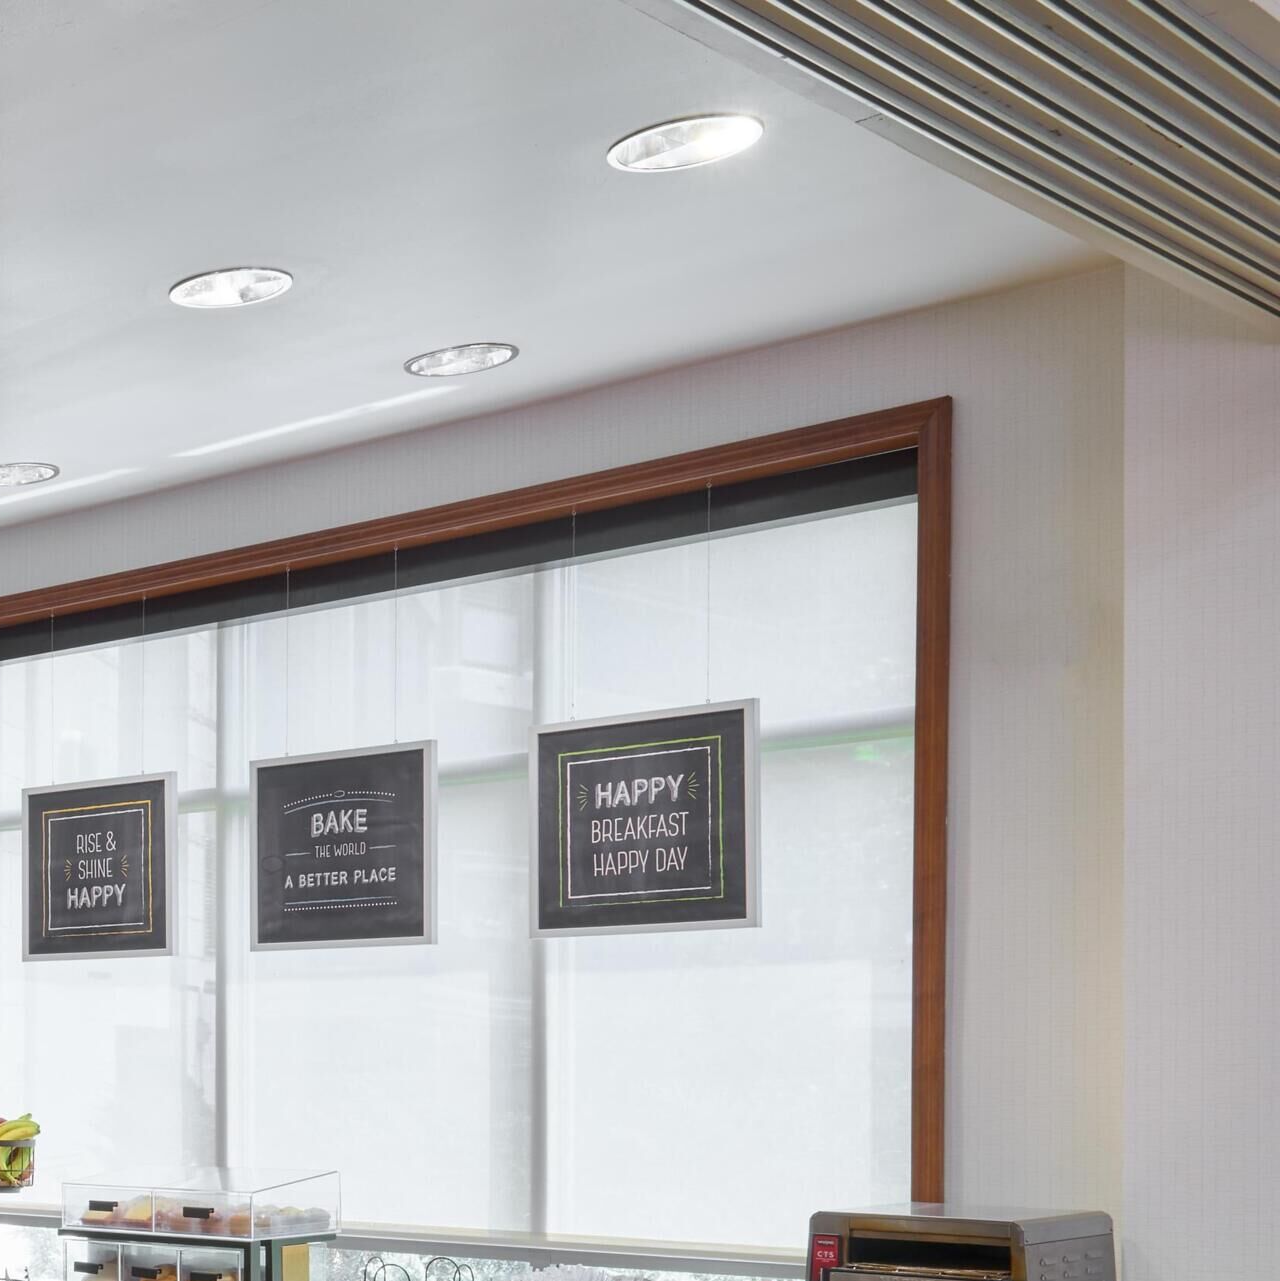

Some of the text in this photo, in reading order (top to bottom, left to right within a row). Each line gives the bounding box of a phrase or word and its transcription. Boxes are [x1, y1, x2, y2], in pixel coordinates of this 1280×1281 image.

[595, 774, 685, 809] HAPPY
[311, 808, 368, 838] BAKE
[591, 811, 689, 844] BREAKFAST
[76, 830, 116, 854] RISE &
[315, 841, 367, 858] THE WORLD
[78, 857, 113, 880] SHINE
[594, 846, 688, 877] HAPPY DAY
[285, 867, 396, 889] A BETTER PLACE
[67, 883, 126, 910] HAPPY
